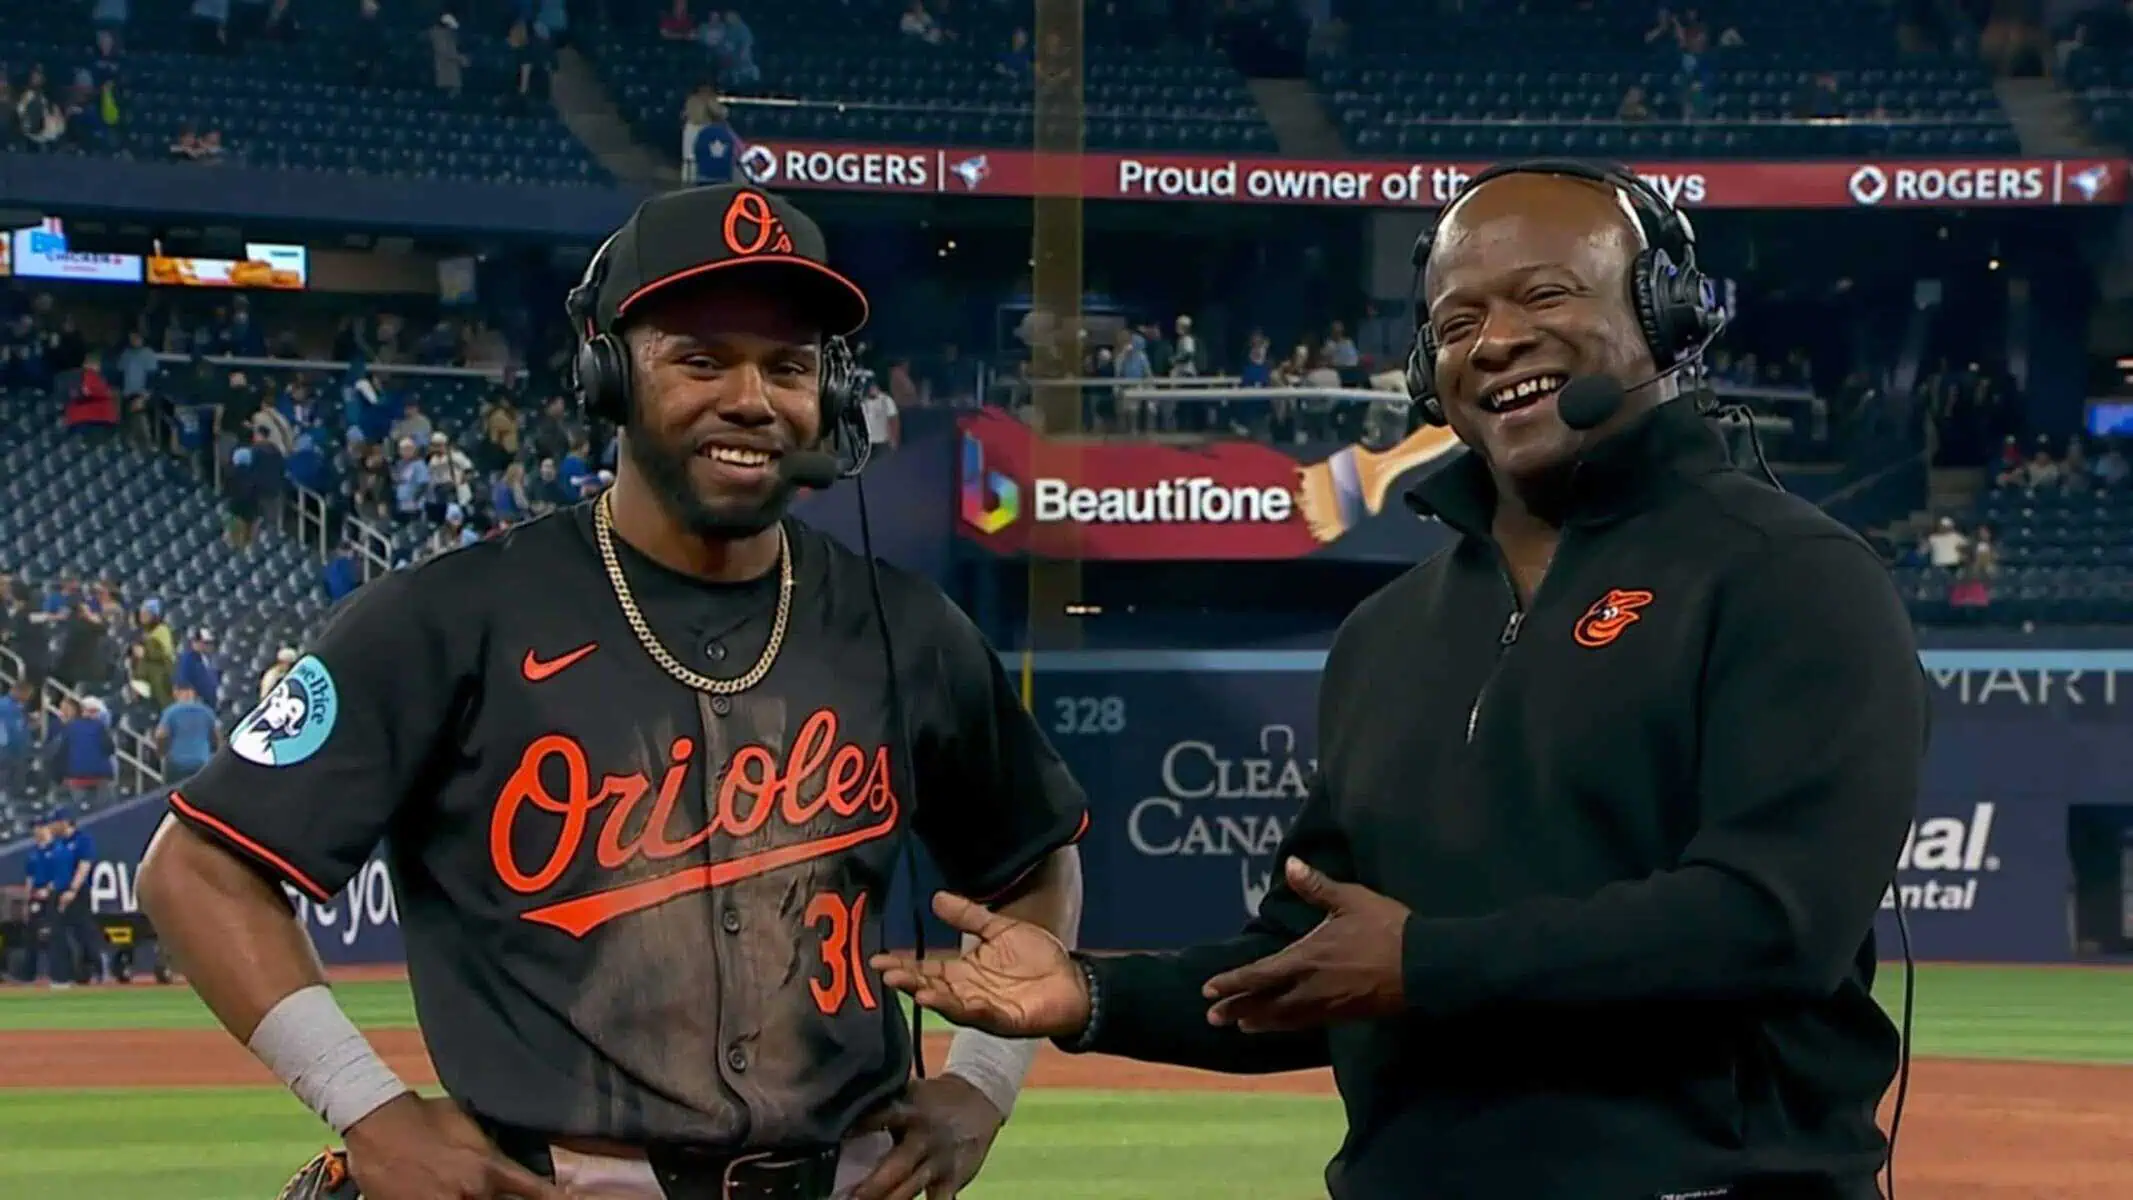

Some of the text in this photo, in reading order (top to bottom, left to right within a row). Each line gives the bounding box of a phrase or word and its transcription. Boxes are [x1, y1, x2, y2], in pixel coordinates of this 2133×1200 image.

[785, 150, 928, 186] ROGERS
[1119, 160, 1237, 196] Proud
[1248, 170, 1371, 200] owner
[1381, 165, 1422, 201] of
[1431, 165, 1469, 203] th
[1898, 168, 2043, 200] ROGERS
[723, 190, 793, 254] O's
[1054, 696, 1126, 734] 328
[1162, 740, 1318, 799] CLEA
[489, 707, 898, 896] Orioles
[1127, 797, 1299, 856] CANA
[343, 860, 400, 945] yo
